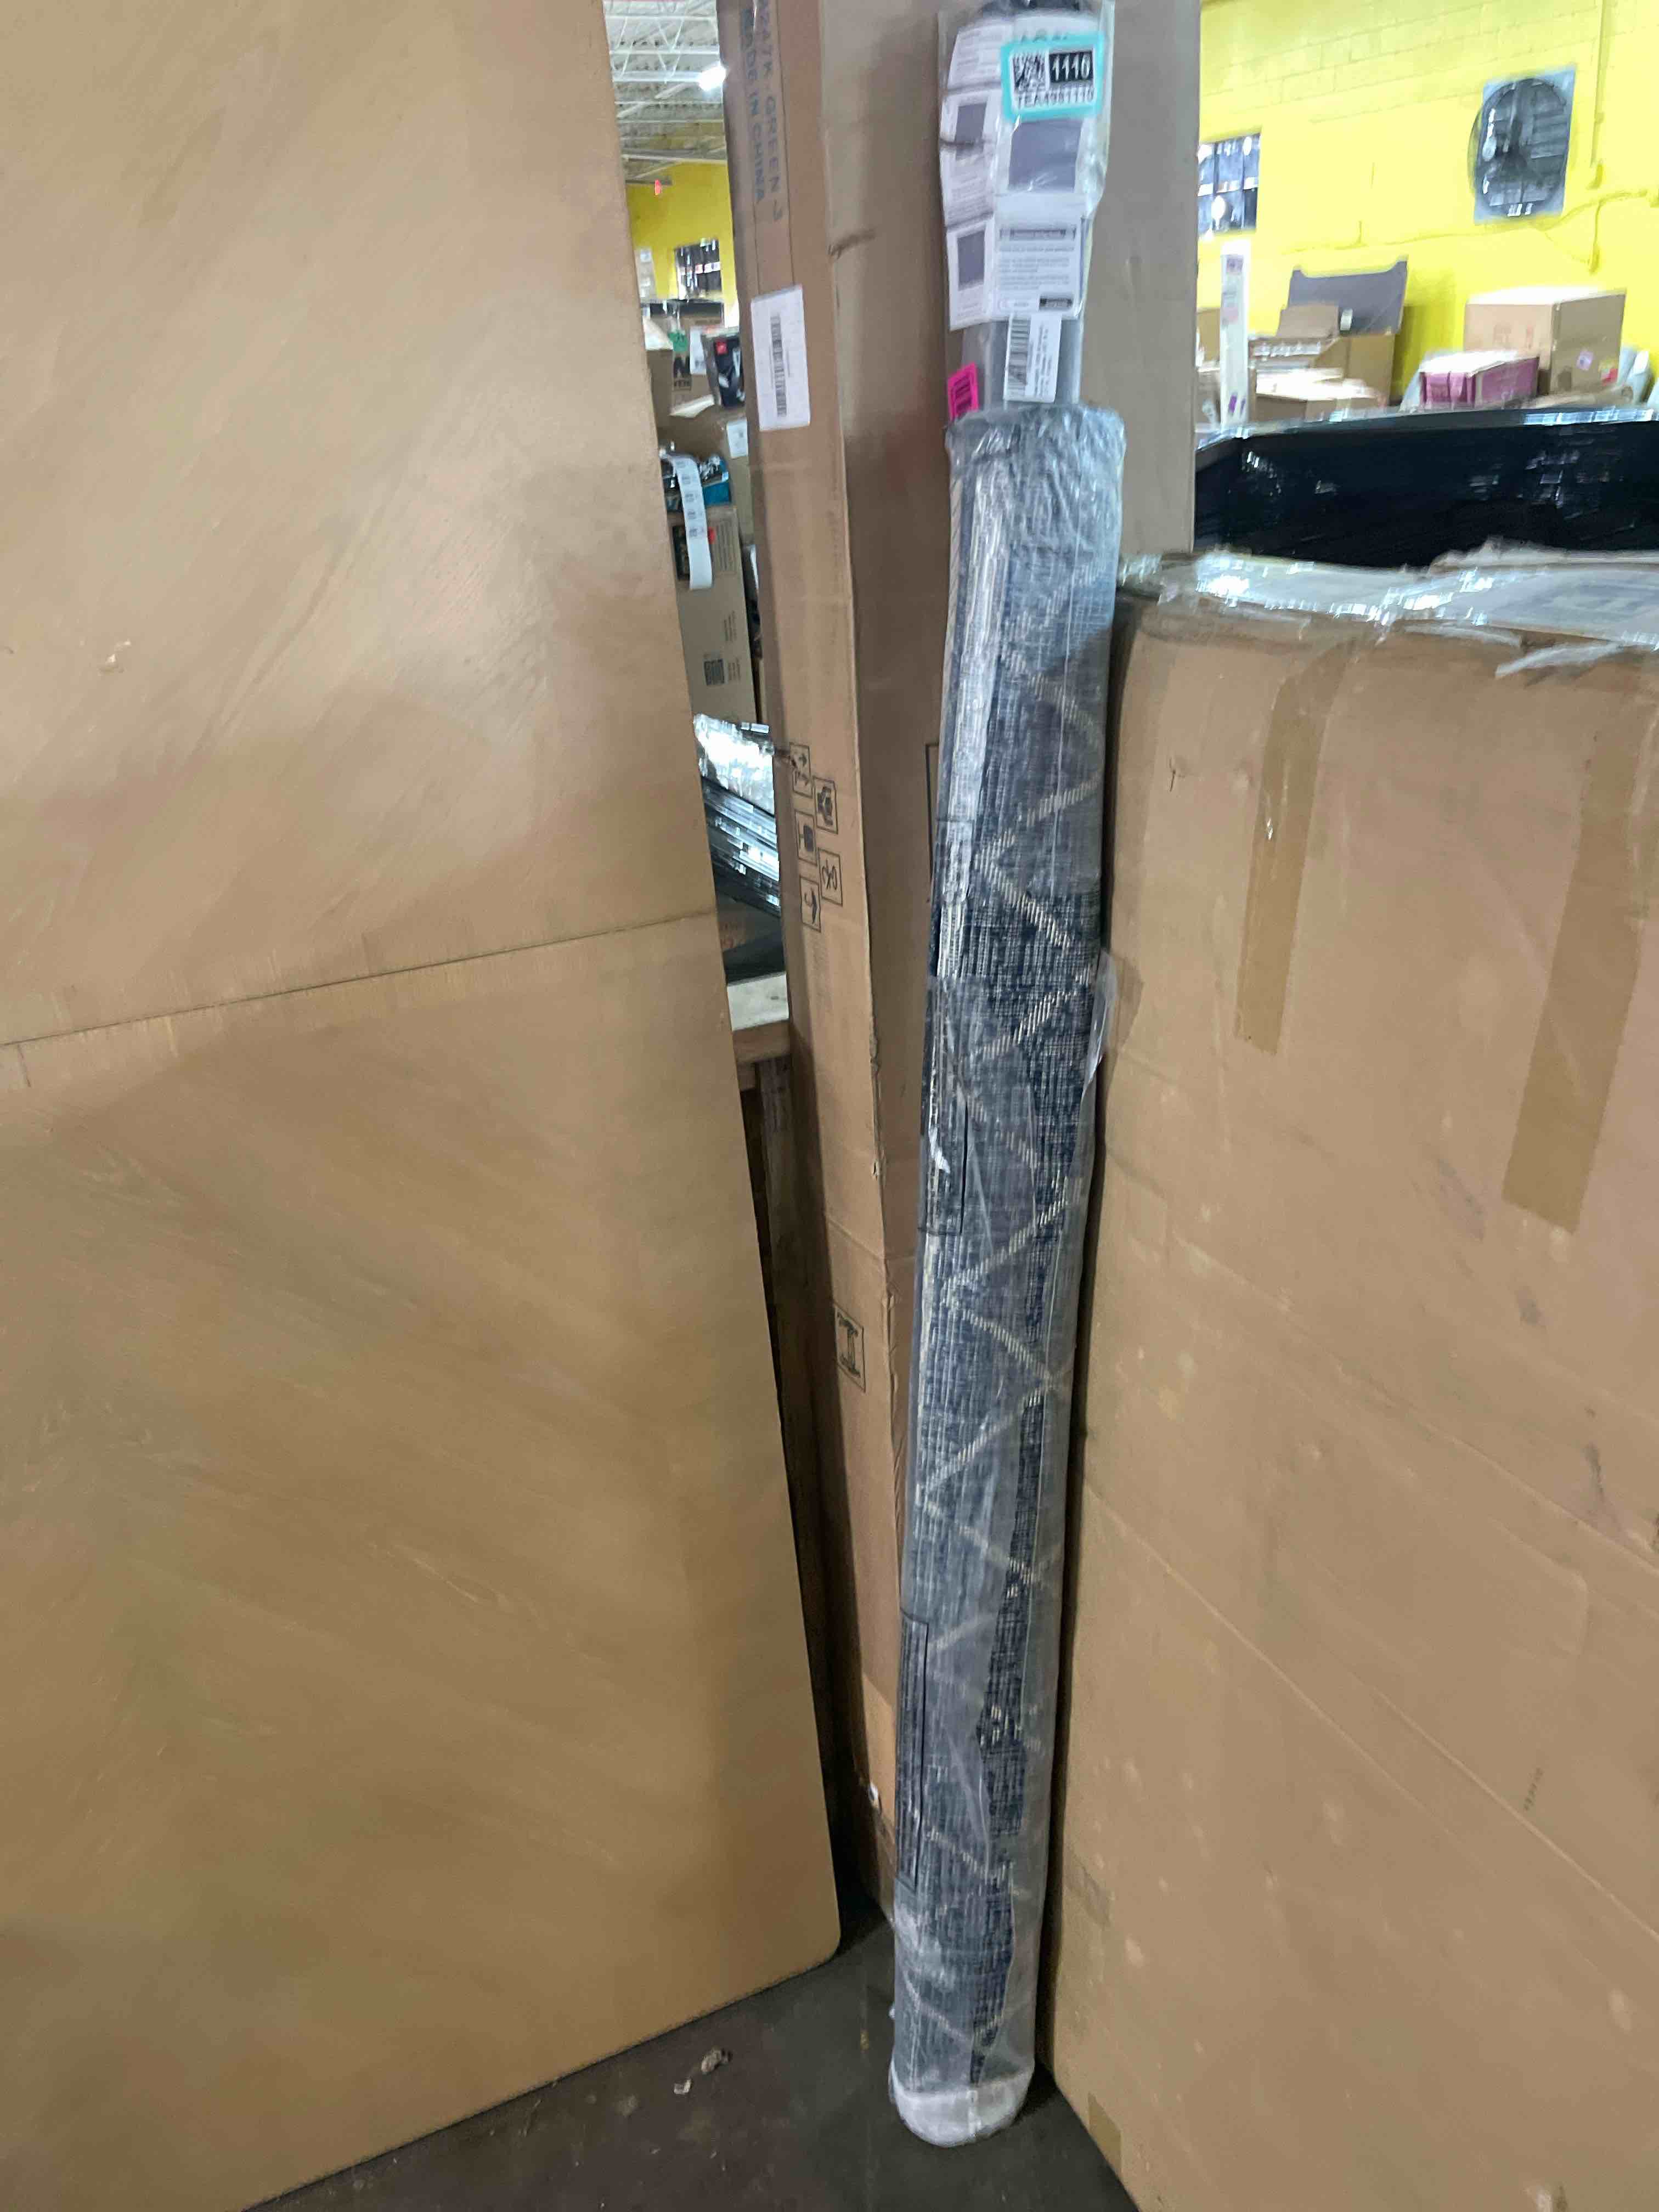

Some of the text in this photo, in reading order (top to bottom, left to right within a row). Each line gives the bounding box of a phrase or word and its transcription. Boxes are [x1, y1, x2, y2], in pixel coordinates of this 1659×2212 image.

[1052, 55, 1091, 81] 1110
[748, 91, 760, 115] IN
[752, 123, 765, 203] CHINA
